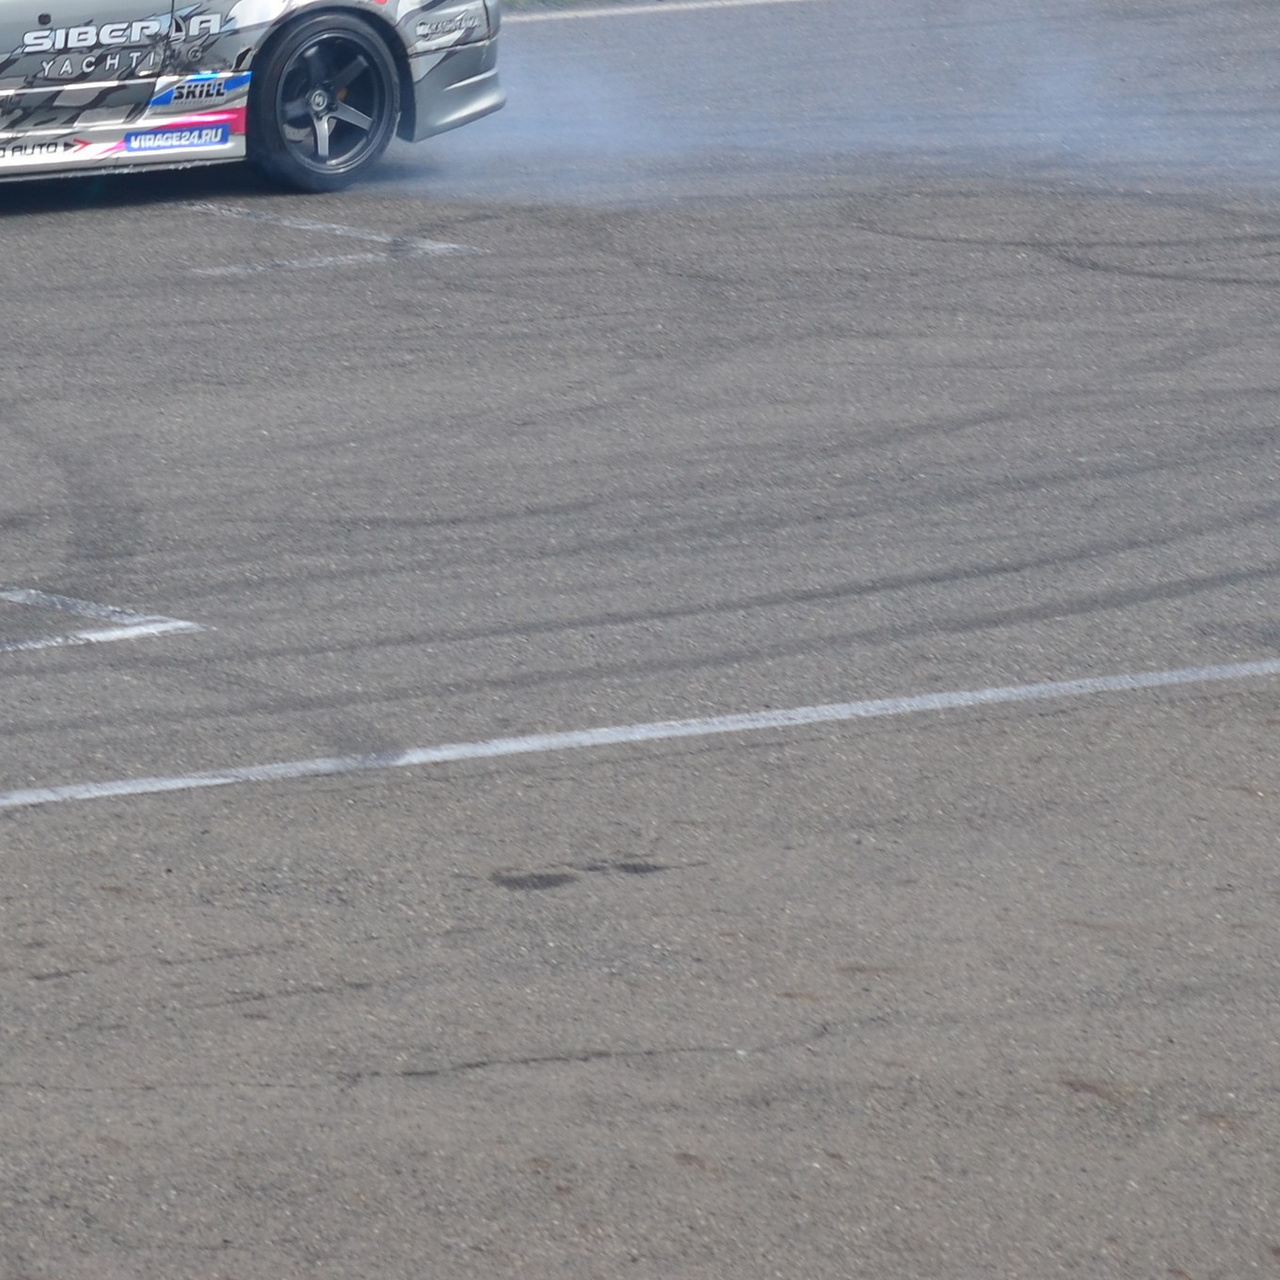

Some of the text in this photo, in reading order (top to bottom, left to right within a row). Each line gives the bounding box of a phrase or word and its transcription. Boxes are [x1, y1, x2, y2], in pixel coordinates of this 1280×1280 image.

[173, 82, 225, 100] SKILL
[130, 128, 222, 148] VIRAGE24.RU
[11, 142, 58, 157] AUTO
